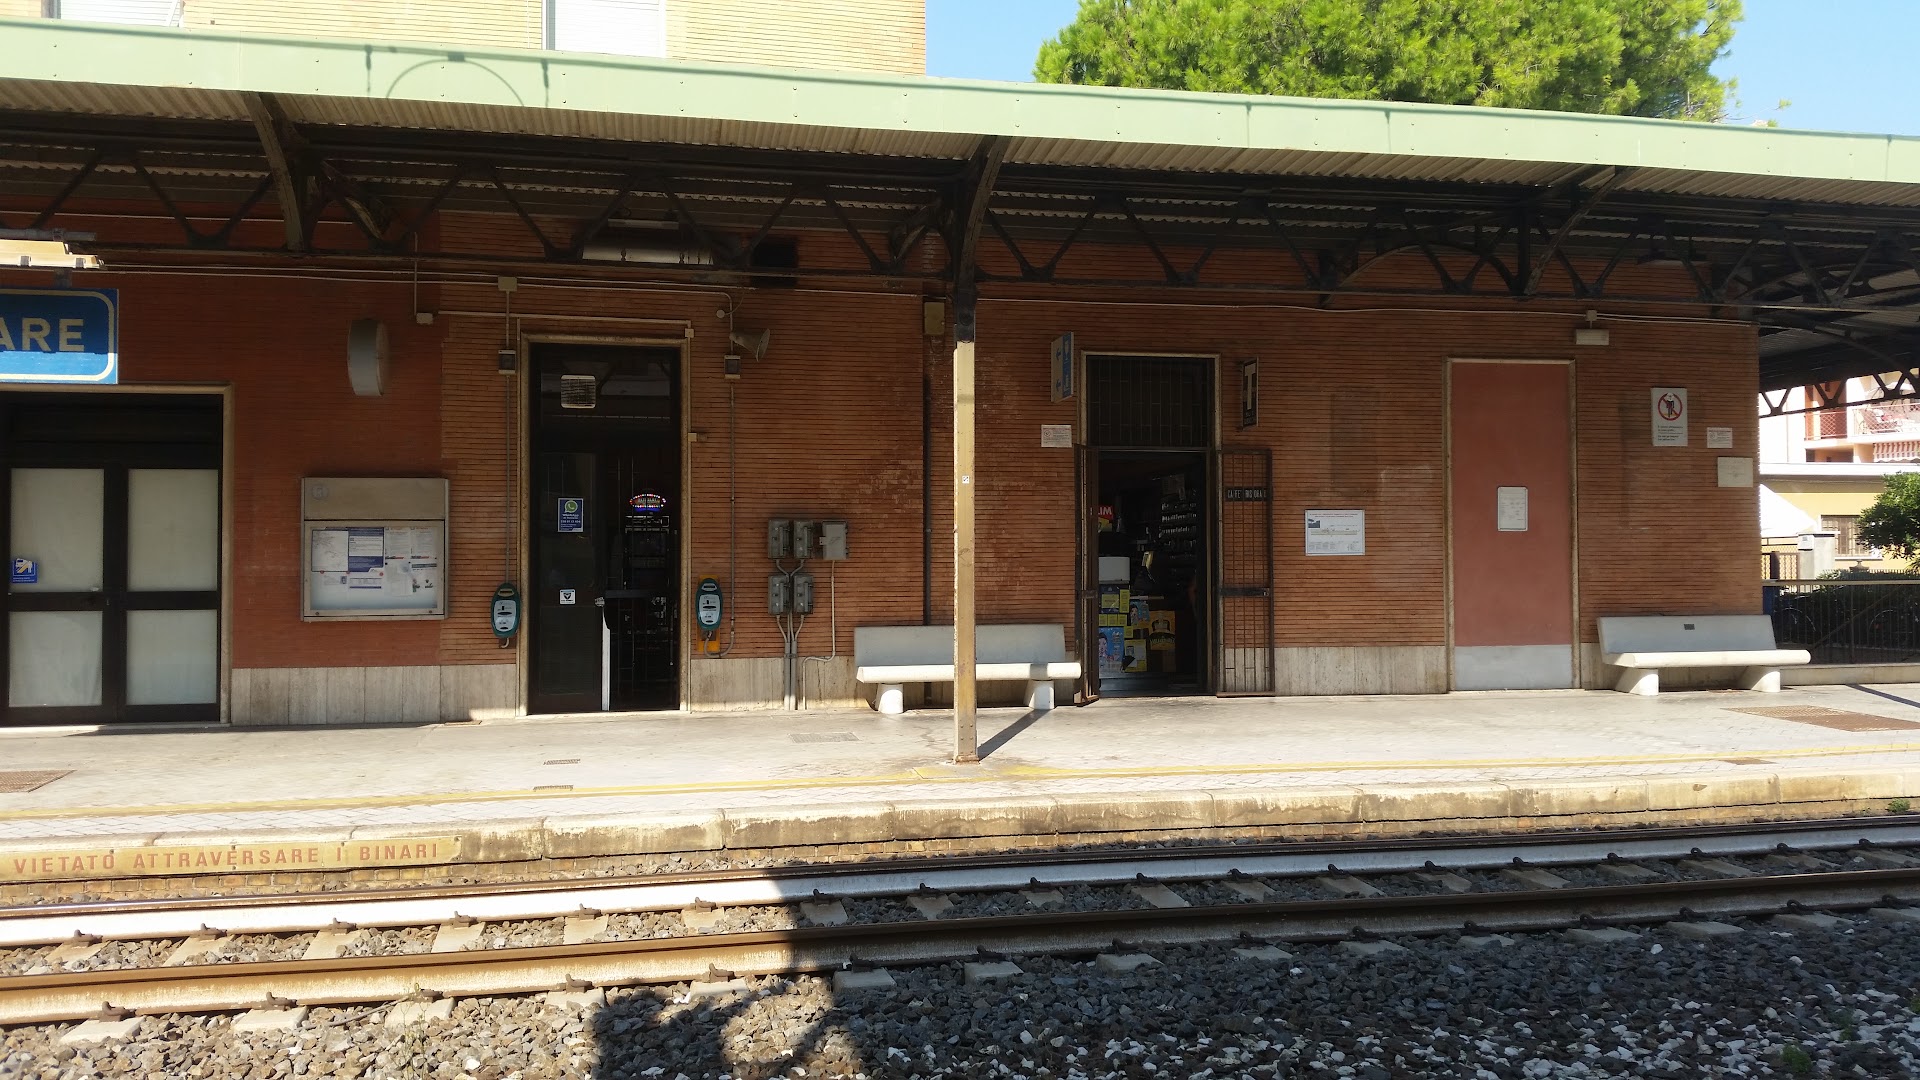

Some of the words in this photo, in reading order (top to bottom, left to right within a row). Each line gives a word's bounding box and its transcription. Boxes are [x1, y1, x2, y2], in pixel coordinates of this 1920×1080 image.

[14, 853, 115, 874] VIETATO
[133, 847, 319, 870] ATTRAVERSARE
[336, 847, 342, 862] I
[359, 843, 437, 861] BINARI
